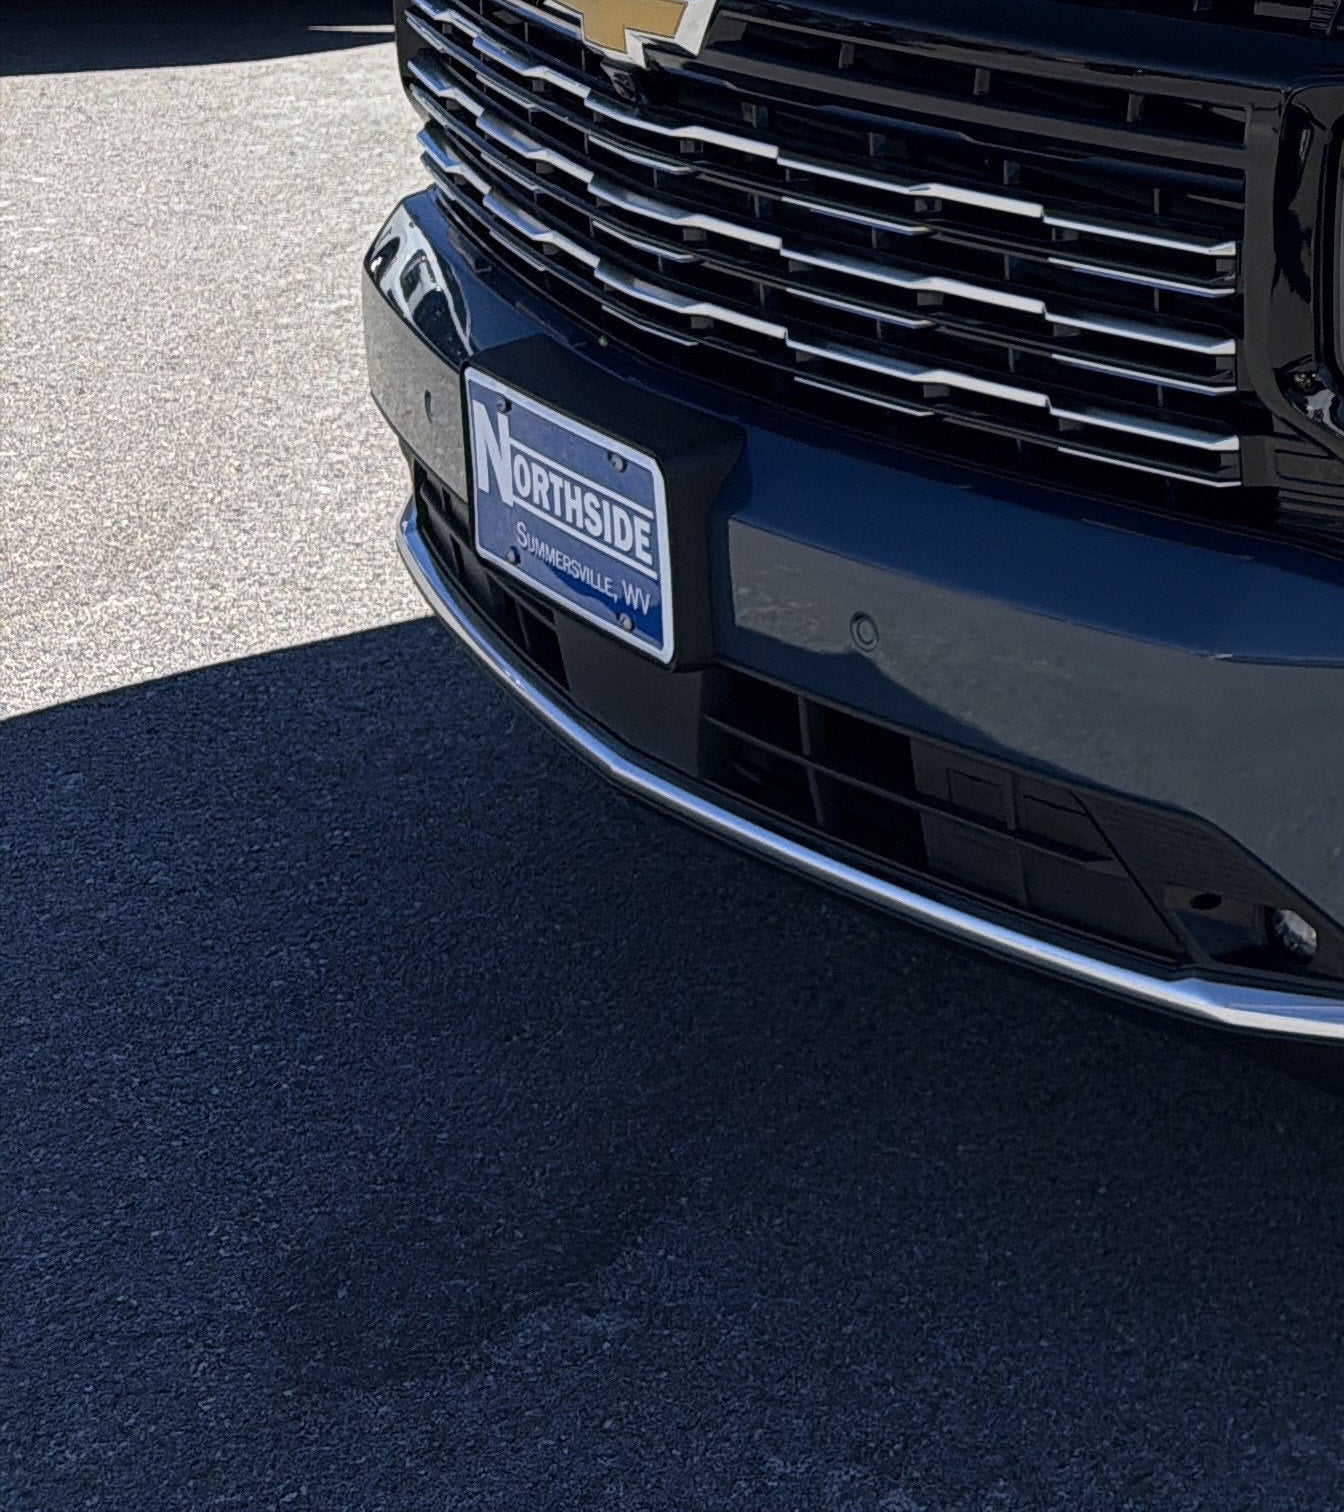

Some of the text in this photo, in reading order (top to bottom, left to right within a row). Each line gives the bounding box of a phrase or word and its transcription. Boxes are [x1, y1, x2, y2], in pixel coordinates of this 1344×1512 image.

[472, 399, 653, 566] NORTHSIDE
[516, 521, 651, 616] SUMMERSVILLE, WV
